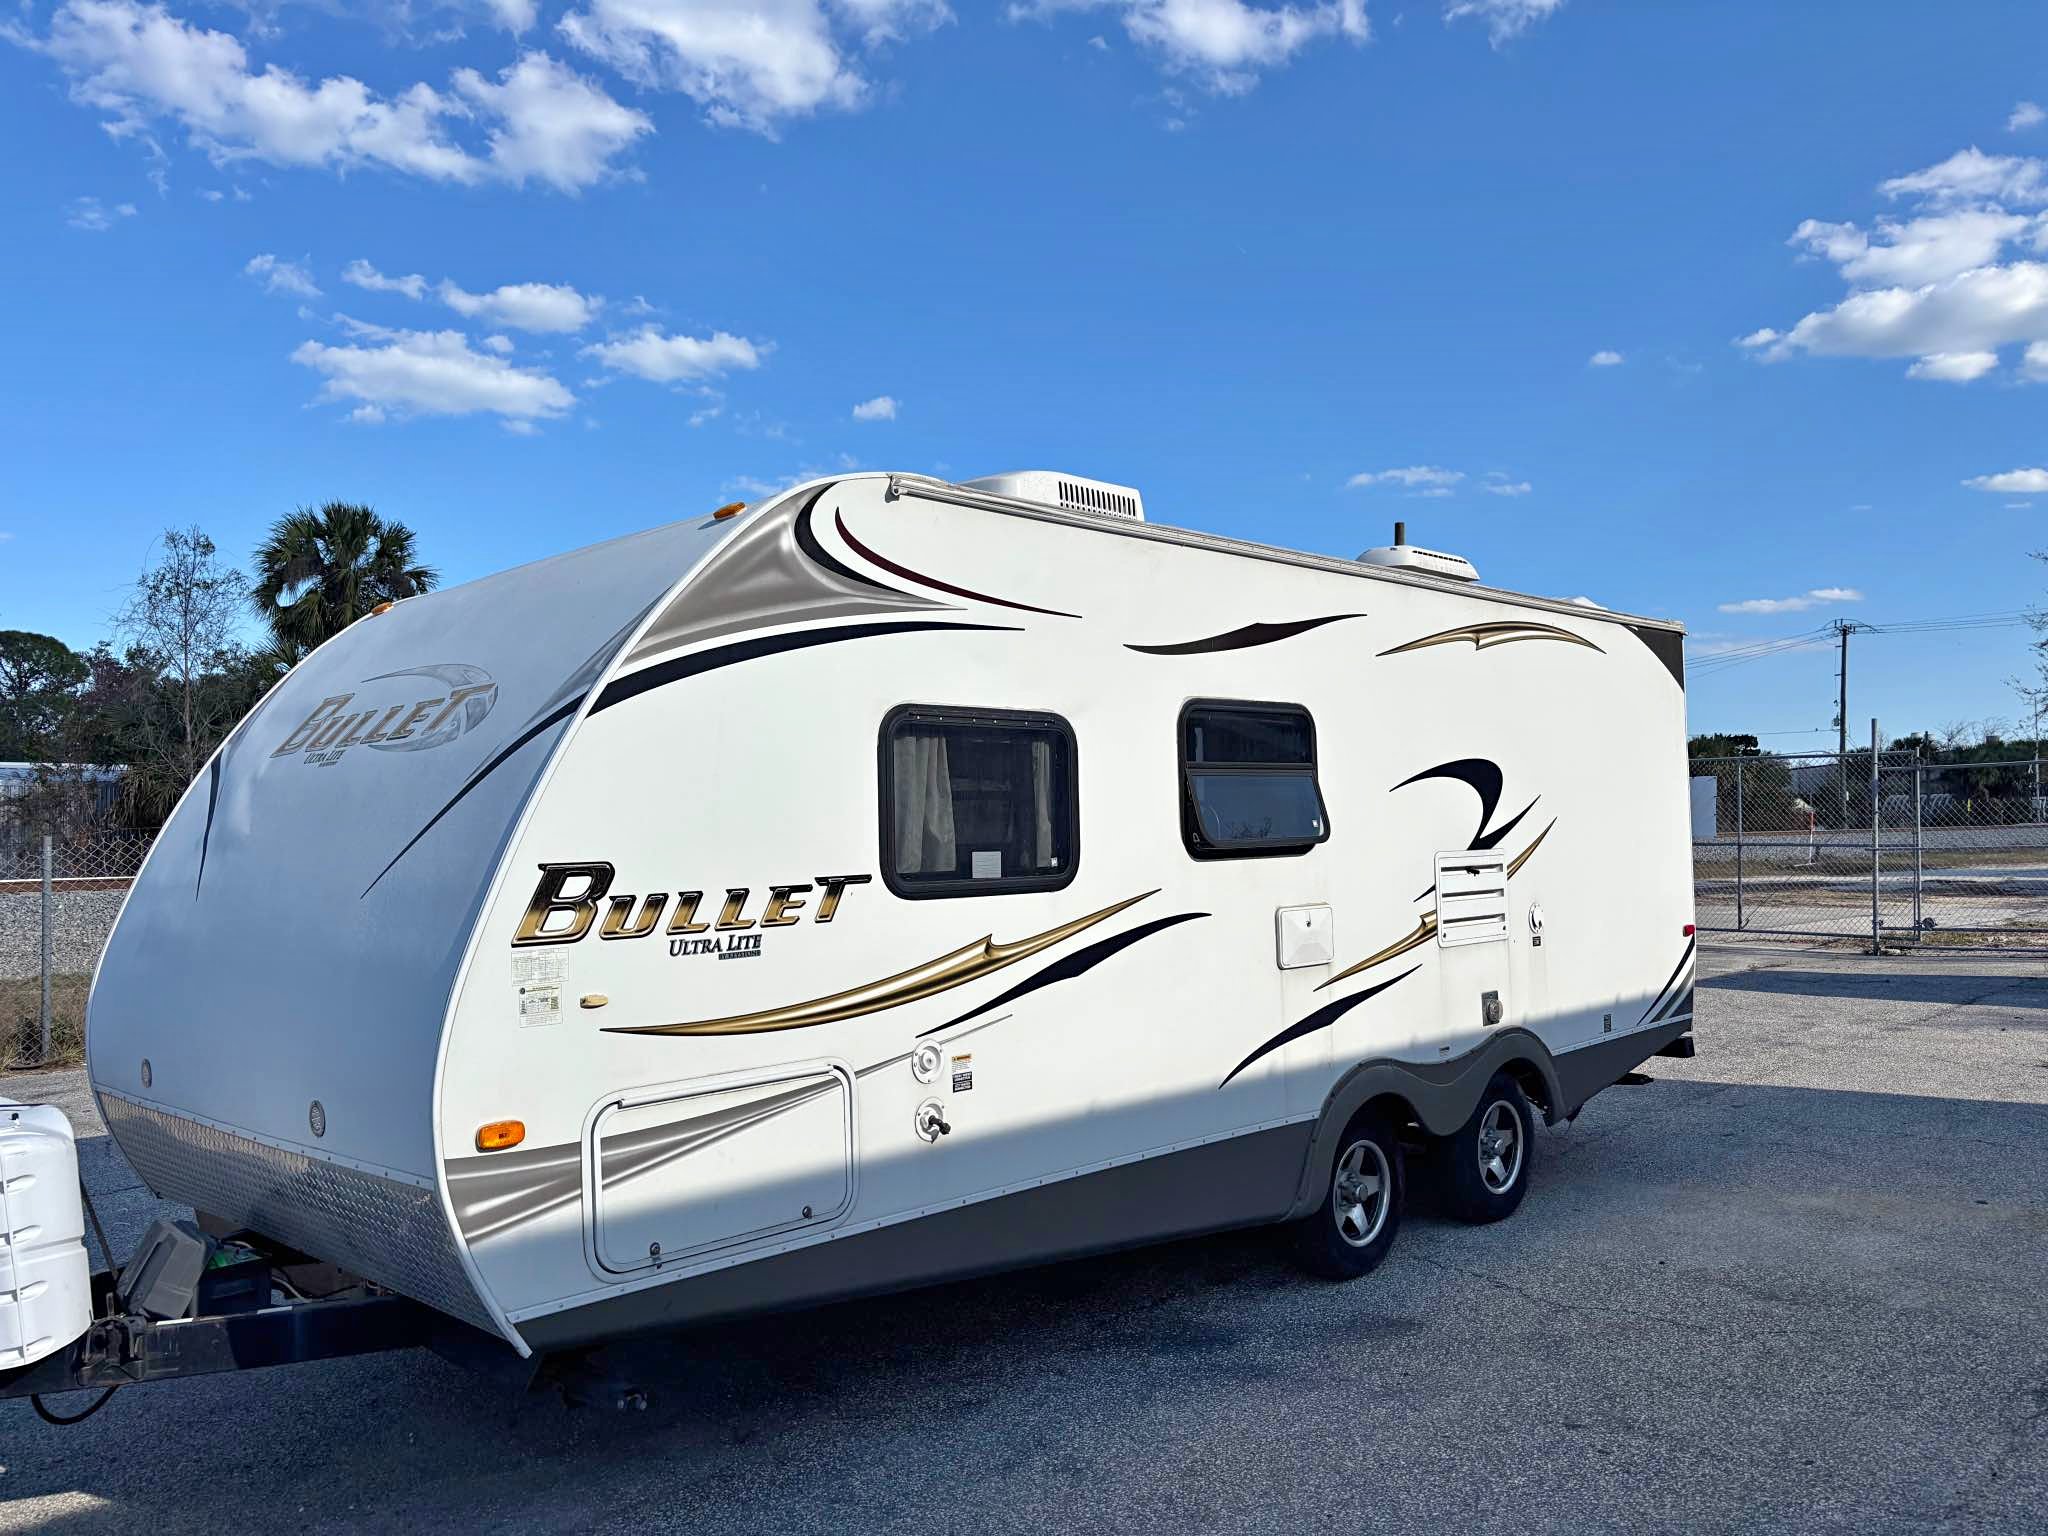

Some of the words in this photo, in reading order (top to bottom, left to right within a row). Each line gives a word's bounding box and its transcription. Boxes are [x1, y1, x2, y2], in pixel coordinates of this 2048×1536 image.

[270, 683, 497, 758] BULLET
[511, 861, 872, 948] BULLET
[669, 938, 723, 957] ULTRA
[726, 934, 762, 951] LITE
